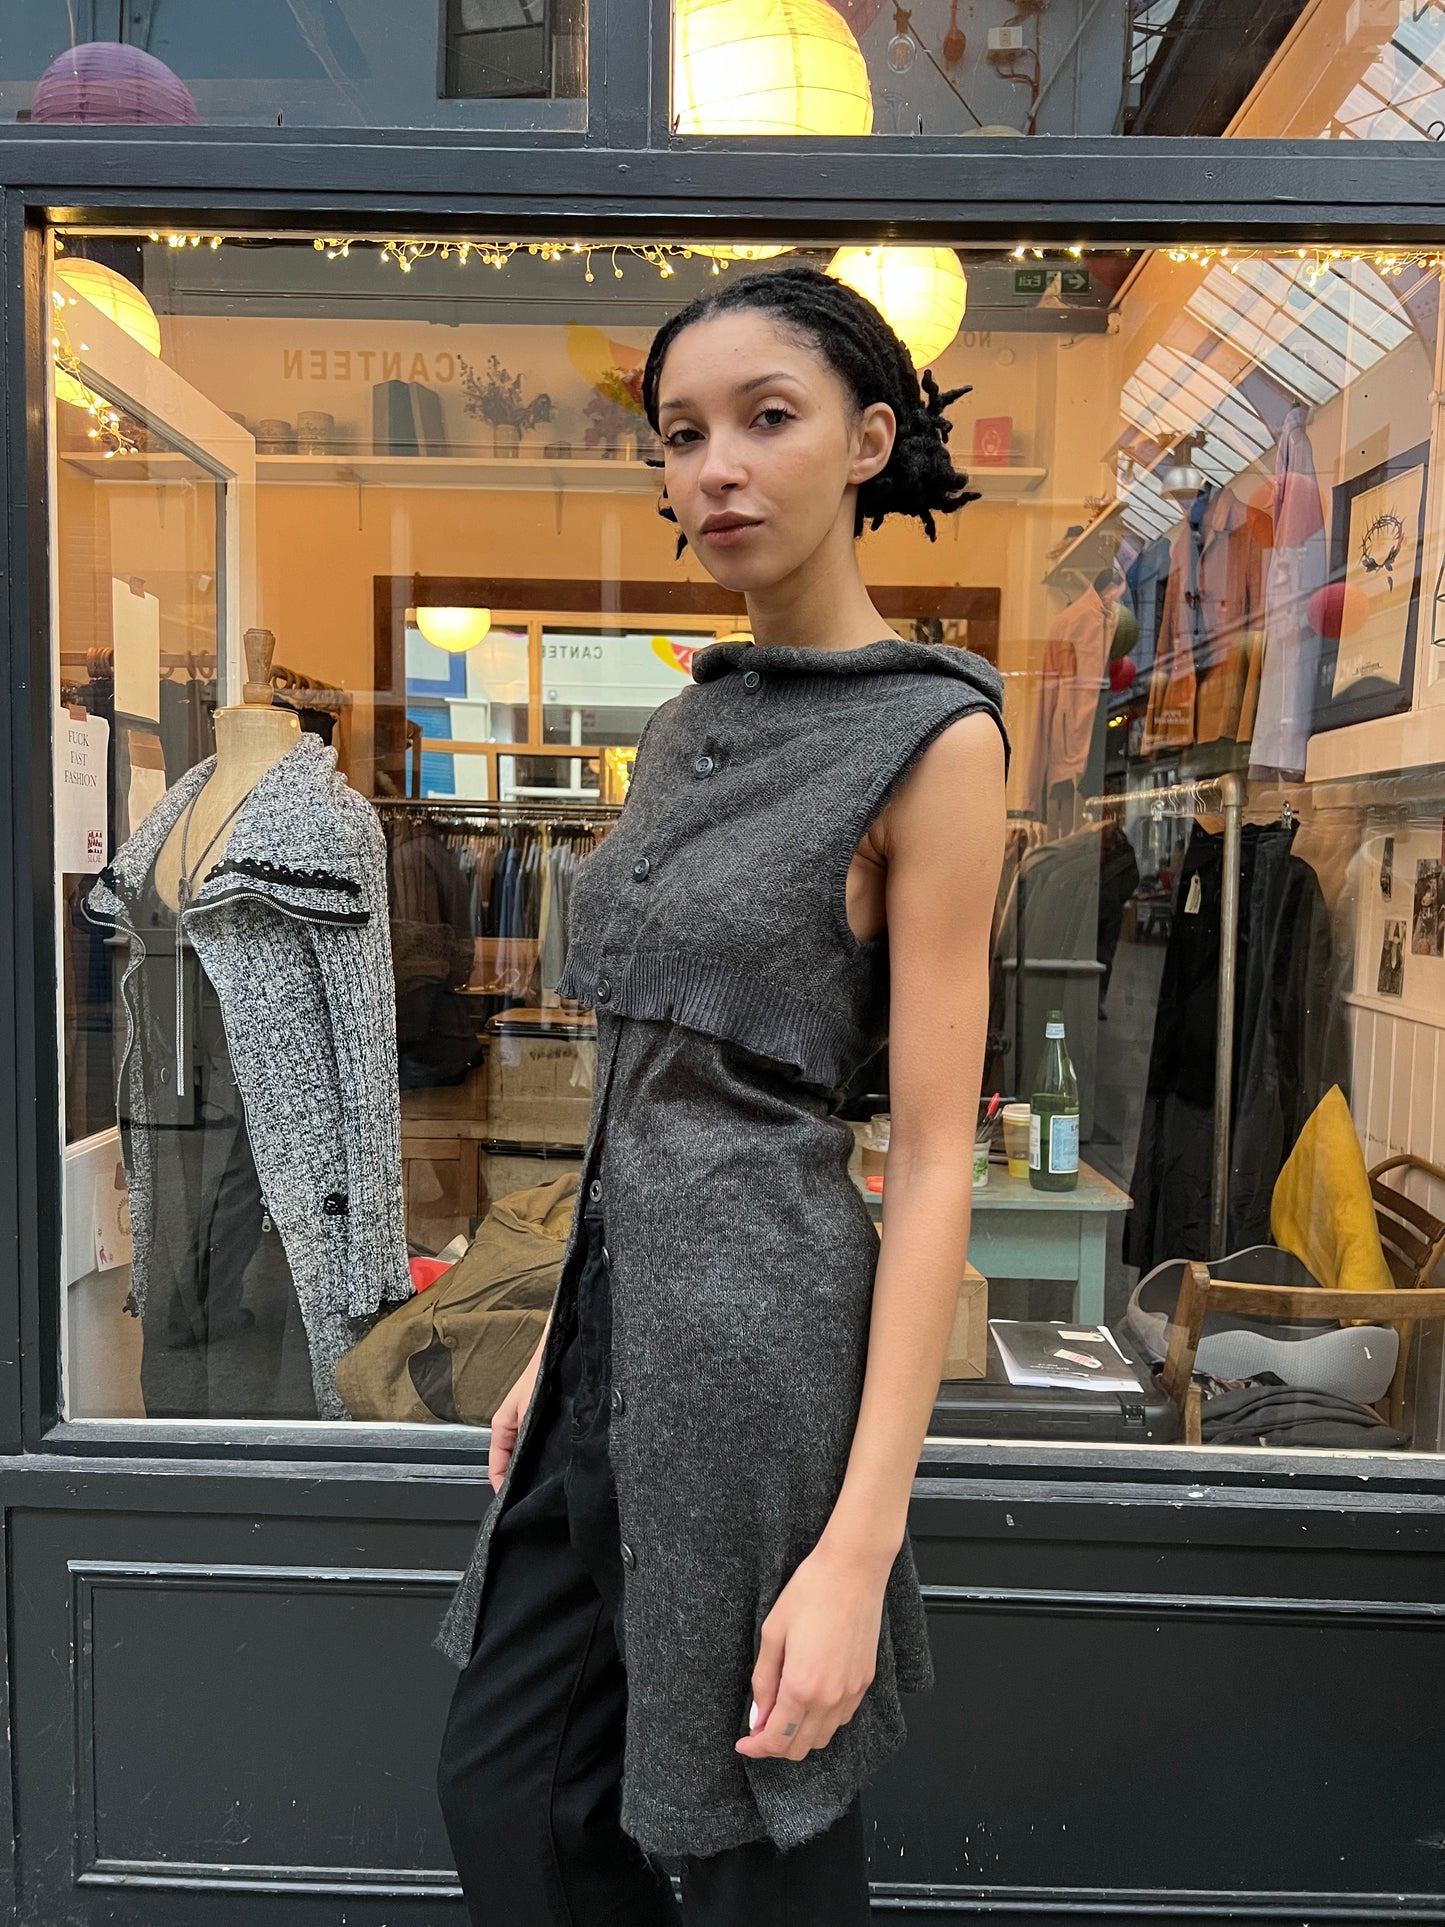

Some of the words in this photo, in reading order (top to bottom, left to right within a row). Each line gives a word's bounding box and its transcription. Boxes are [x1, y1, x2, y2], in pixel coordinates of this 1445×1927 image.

[68, 729, 89, 747] FUCK
[70, 750, 88, 767] FAST
[64, 769, 98, 787] FASHION
